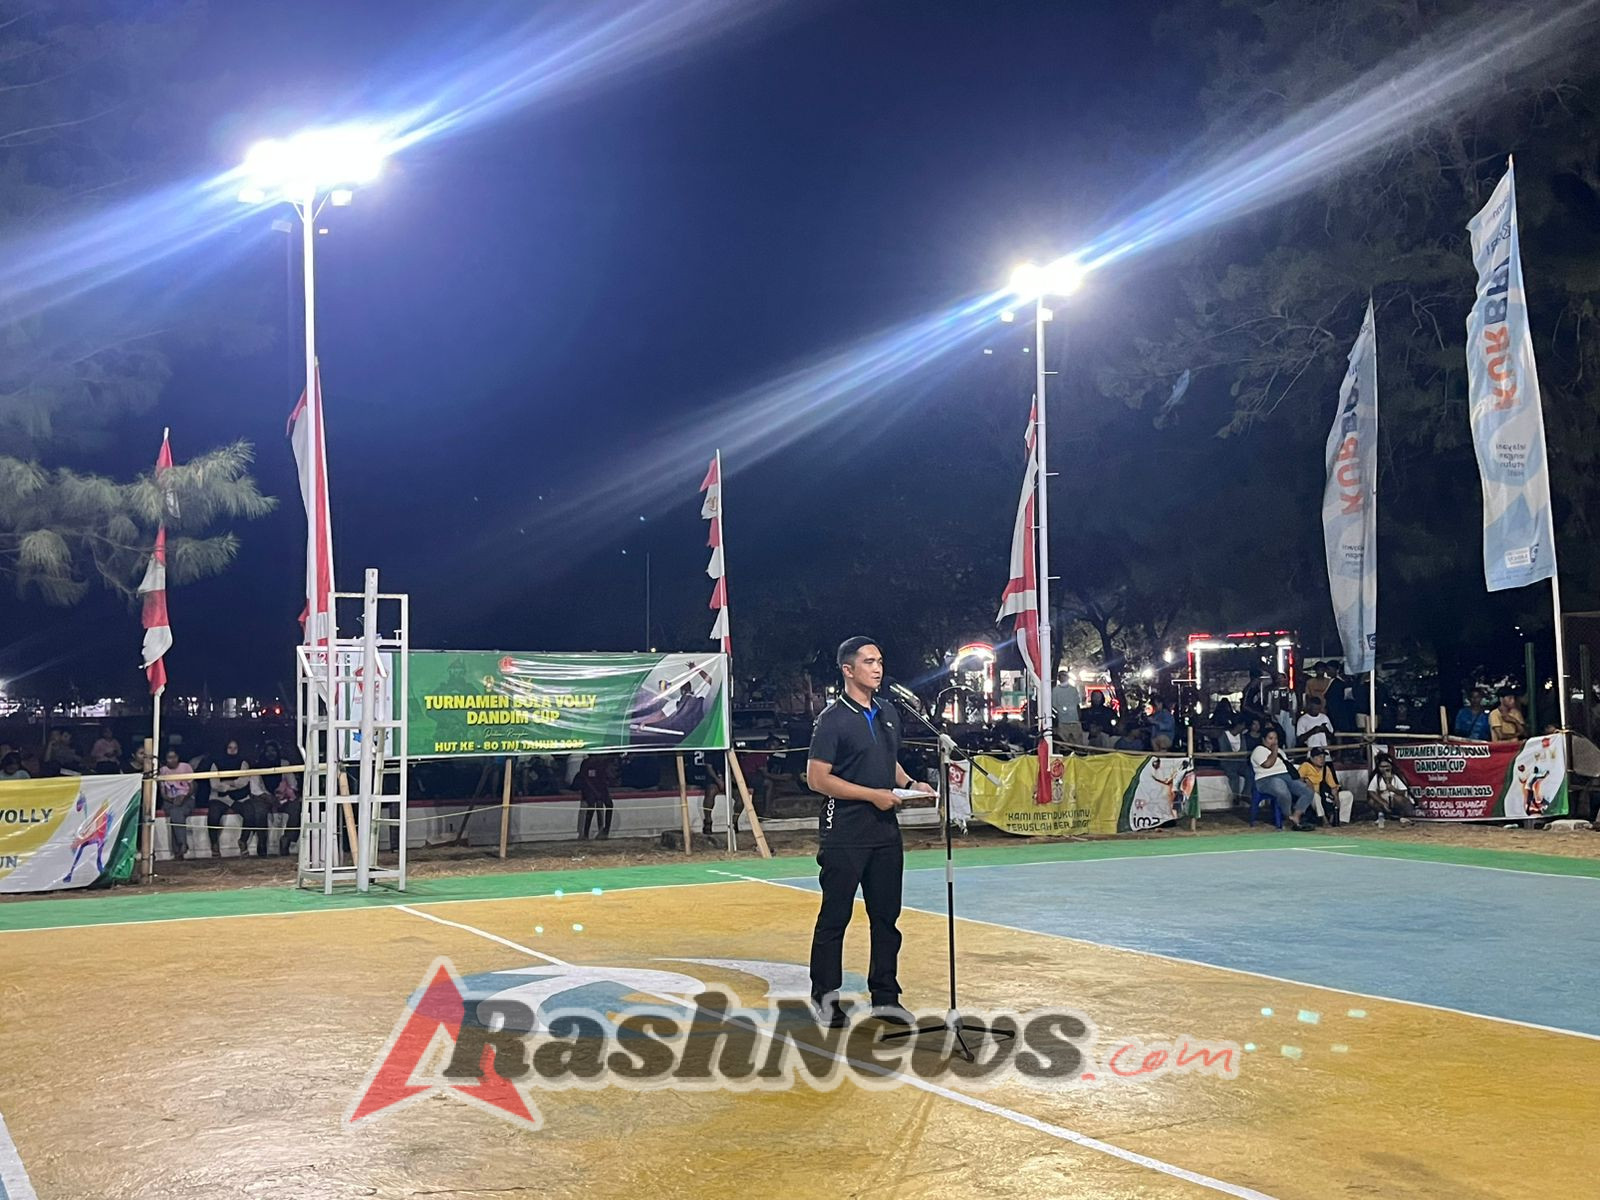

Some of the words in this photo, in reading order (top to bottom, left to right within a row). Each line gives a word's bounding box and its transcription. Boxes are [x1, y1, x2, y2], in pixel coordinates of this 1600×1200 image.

[424, 694, 509, 710] TURNAMEN
[555, 694, 597, 709] VOLLY
[467, 710, 529, 725] DANDIM
[533, 710, 560, 724] CUP
[434, 741, 458, 752] HUT
[460, 741, 475, 752] KE
[484, 740, 499, 751] 80
[1395, 746, 1436, 758] TURNAMEN
[1415, 760, 1447, 772] DANDIM
[1449, 760, 1466, 771] CUP
[1448, 786, 1473, 797] TAHUN
[1473, 786, 1492, 796] 2025
[826, 795, 835, 829] LACOS
